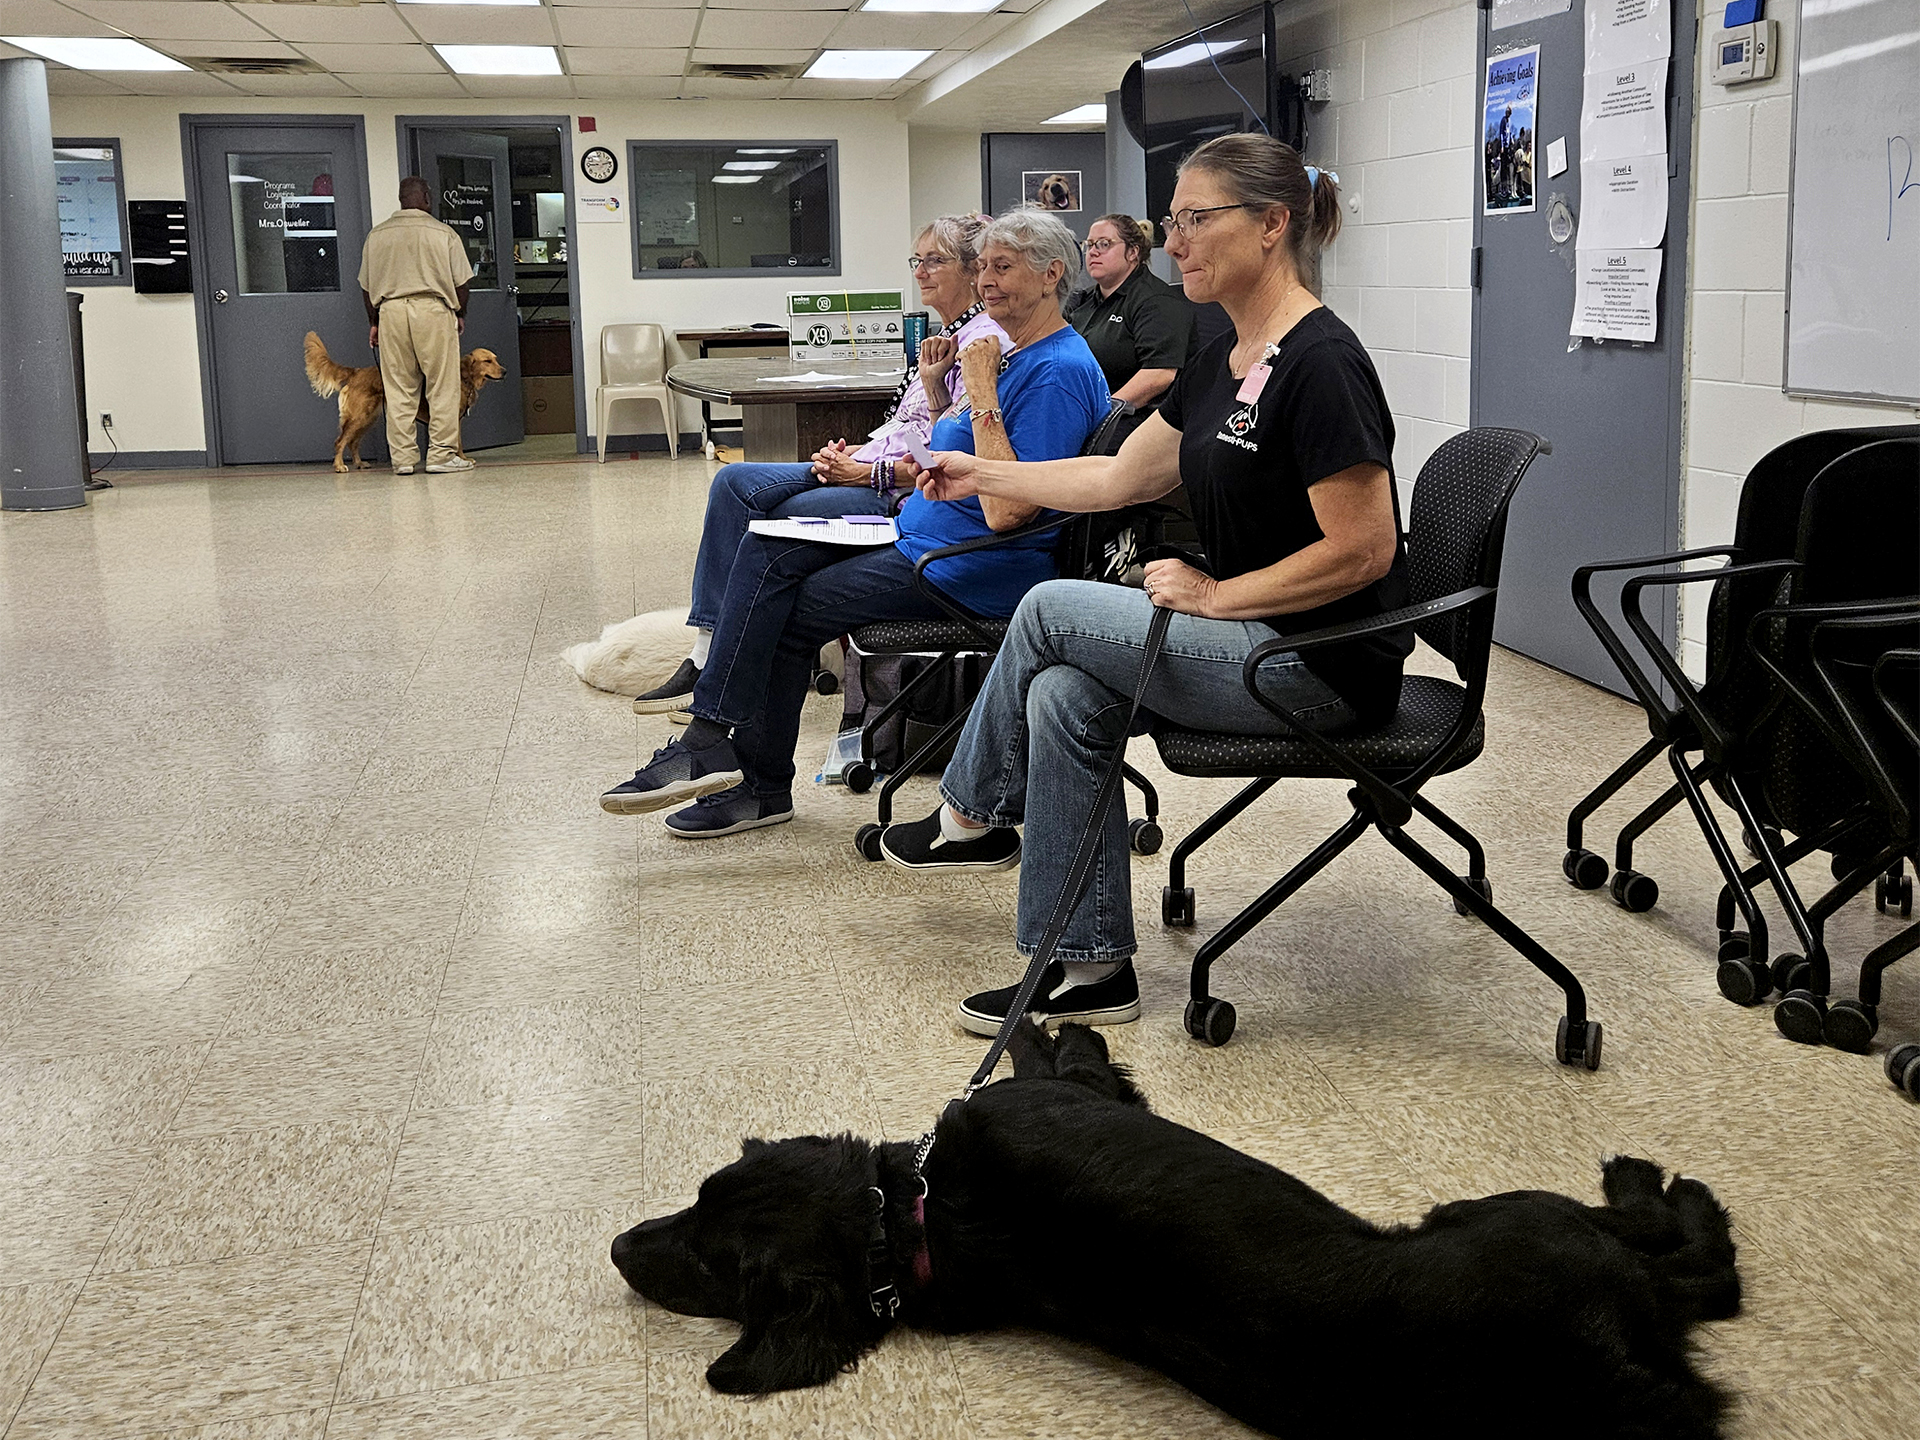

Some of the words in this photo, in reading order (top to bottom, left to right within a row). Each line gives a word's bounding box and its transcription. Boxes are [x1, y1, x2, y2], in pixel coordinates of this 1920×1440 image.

[1489, 68, 1516, 87] Achieving
[1518, 62, 1534, 80] Goals
[1617, 73, 1630, 84] Level
[1632, 72, 1635, 81] 3
[1613, 165, 1627, 174] Level
[264, 181, 295, 191] Programs
[266, 190, 294, 200] Logistics
[264, 201, 300, 209] Coordinator
[93, 251, 111, 266] up
